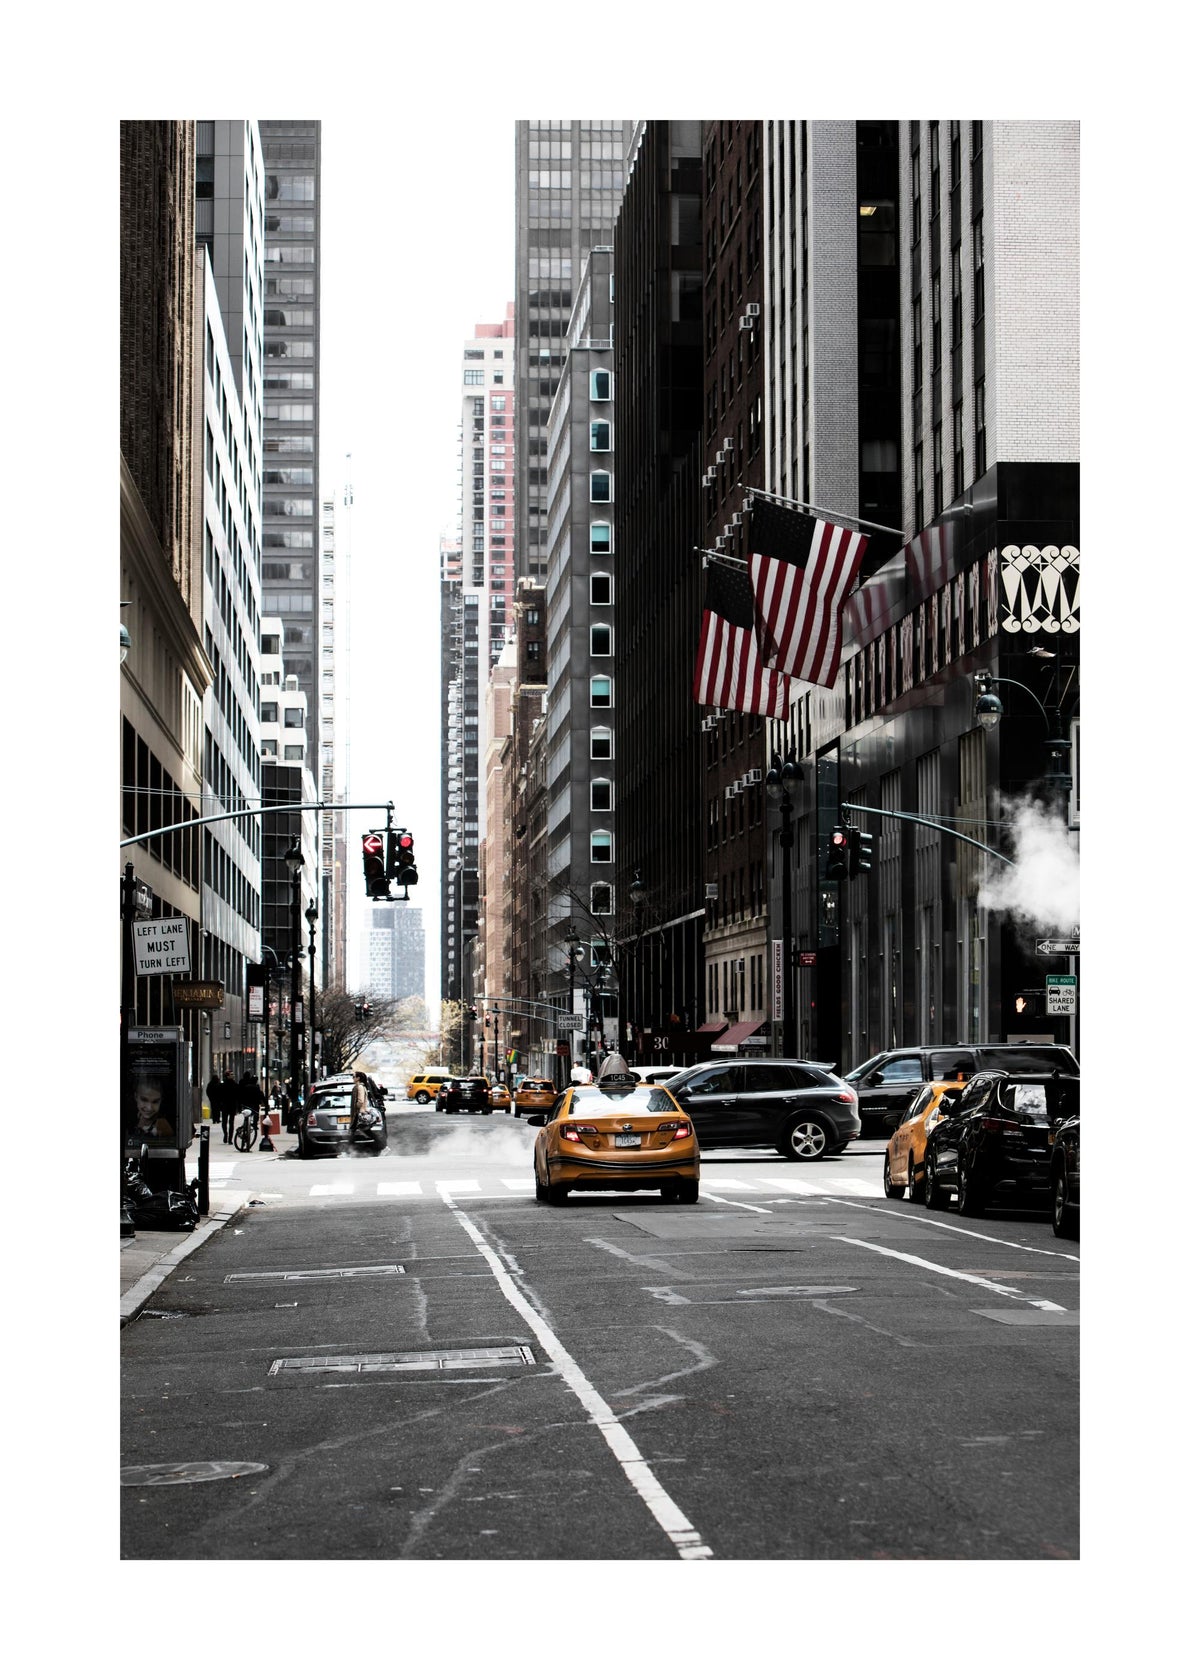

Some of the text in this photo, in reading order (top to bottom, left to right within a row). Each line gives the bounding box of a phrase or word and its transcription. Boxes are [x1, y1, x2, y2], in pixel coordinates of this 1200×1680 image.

[137, 924, 183, 937] LEFT LANE
[147, 940, 175, 953] MUST
[140, 957, 186, 969] TURN LEFT
[137, 1031, 164, 1039] Phone
